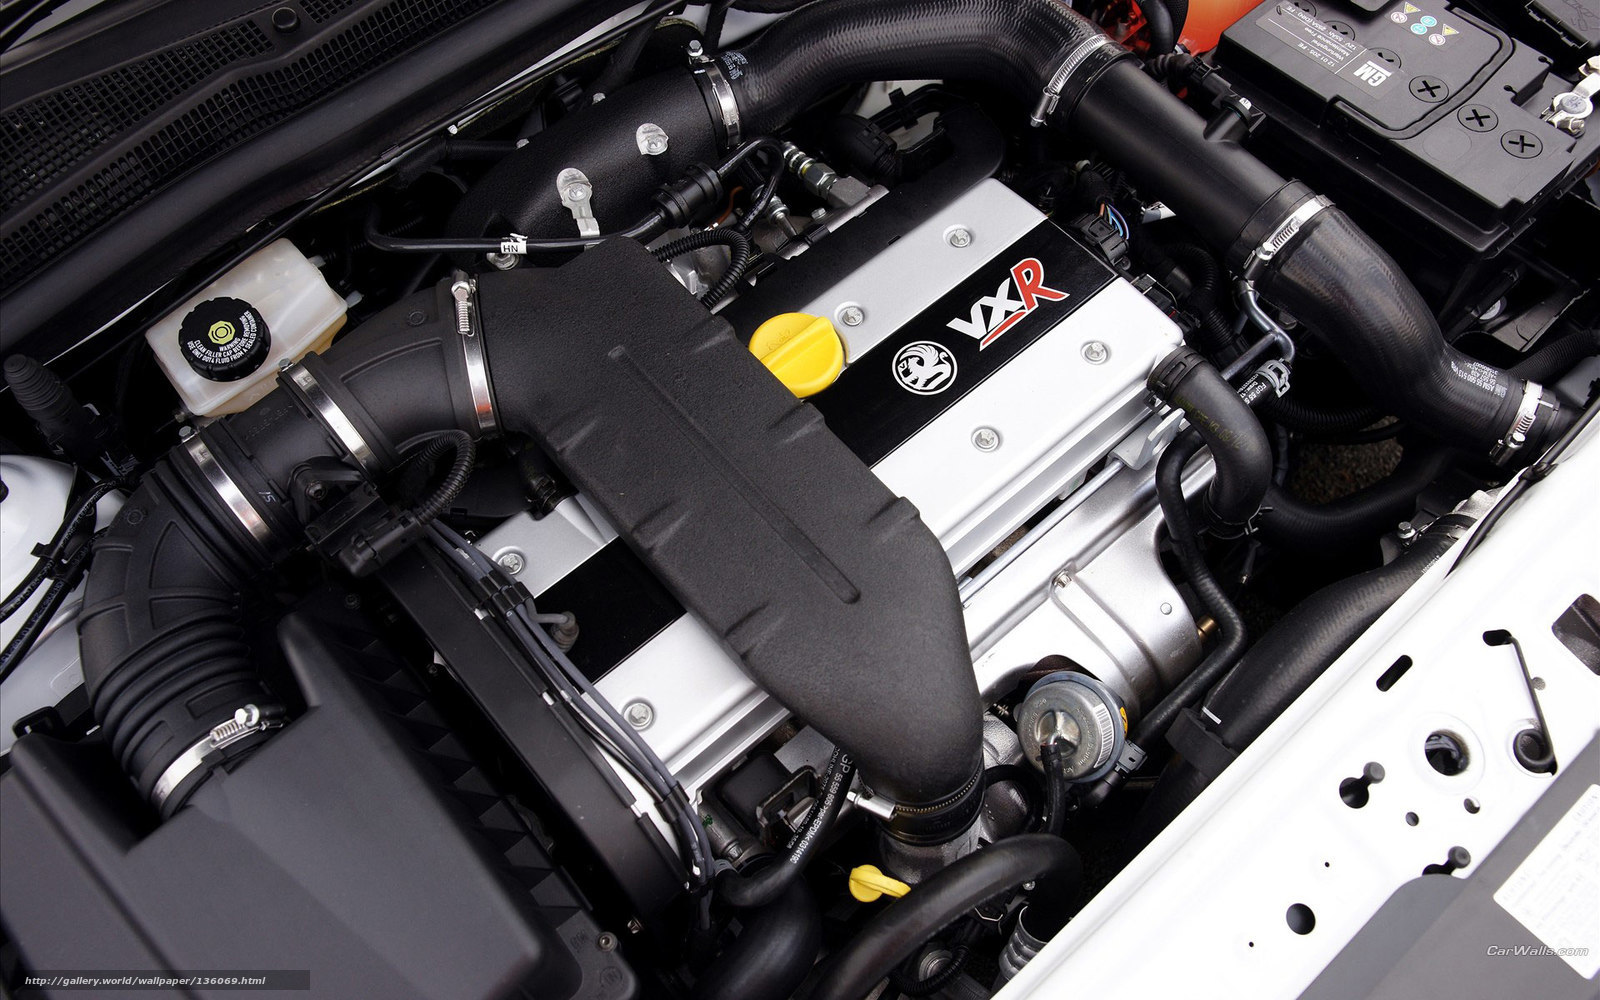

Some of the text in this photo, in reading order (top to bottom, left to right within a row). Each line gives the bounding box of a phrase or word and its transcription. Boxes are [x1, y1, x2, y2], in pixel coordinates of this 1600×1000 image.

[1304, 27, 1350, 57] Maintenance Free
[1311, 39, 1344, 61] Wartungsfrei
[1353, 61, 1391, 87] GM
[946, 257, 1070, 346] VXR
[187, 341, 196, 350] USE
[192, 348, 204, 358] ONLY
[230, 351, 245, 361] FROM
[245, 333, 256, 349] SEALED
[194, 340, 207, 353] CLEAN
[205, 350, 222, 358] FILLER
[219, 337, 240, 352] WARNING
[1256, 382, 1267, 394] FGP
[834, 772, 843, 783] 55
[830, 781, 840, 796] 559
